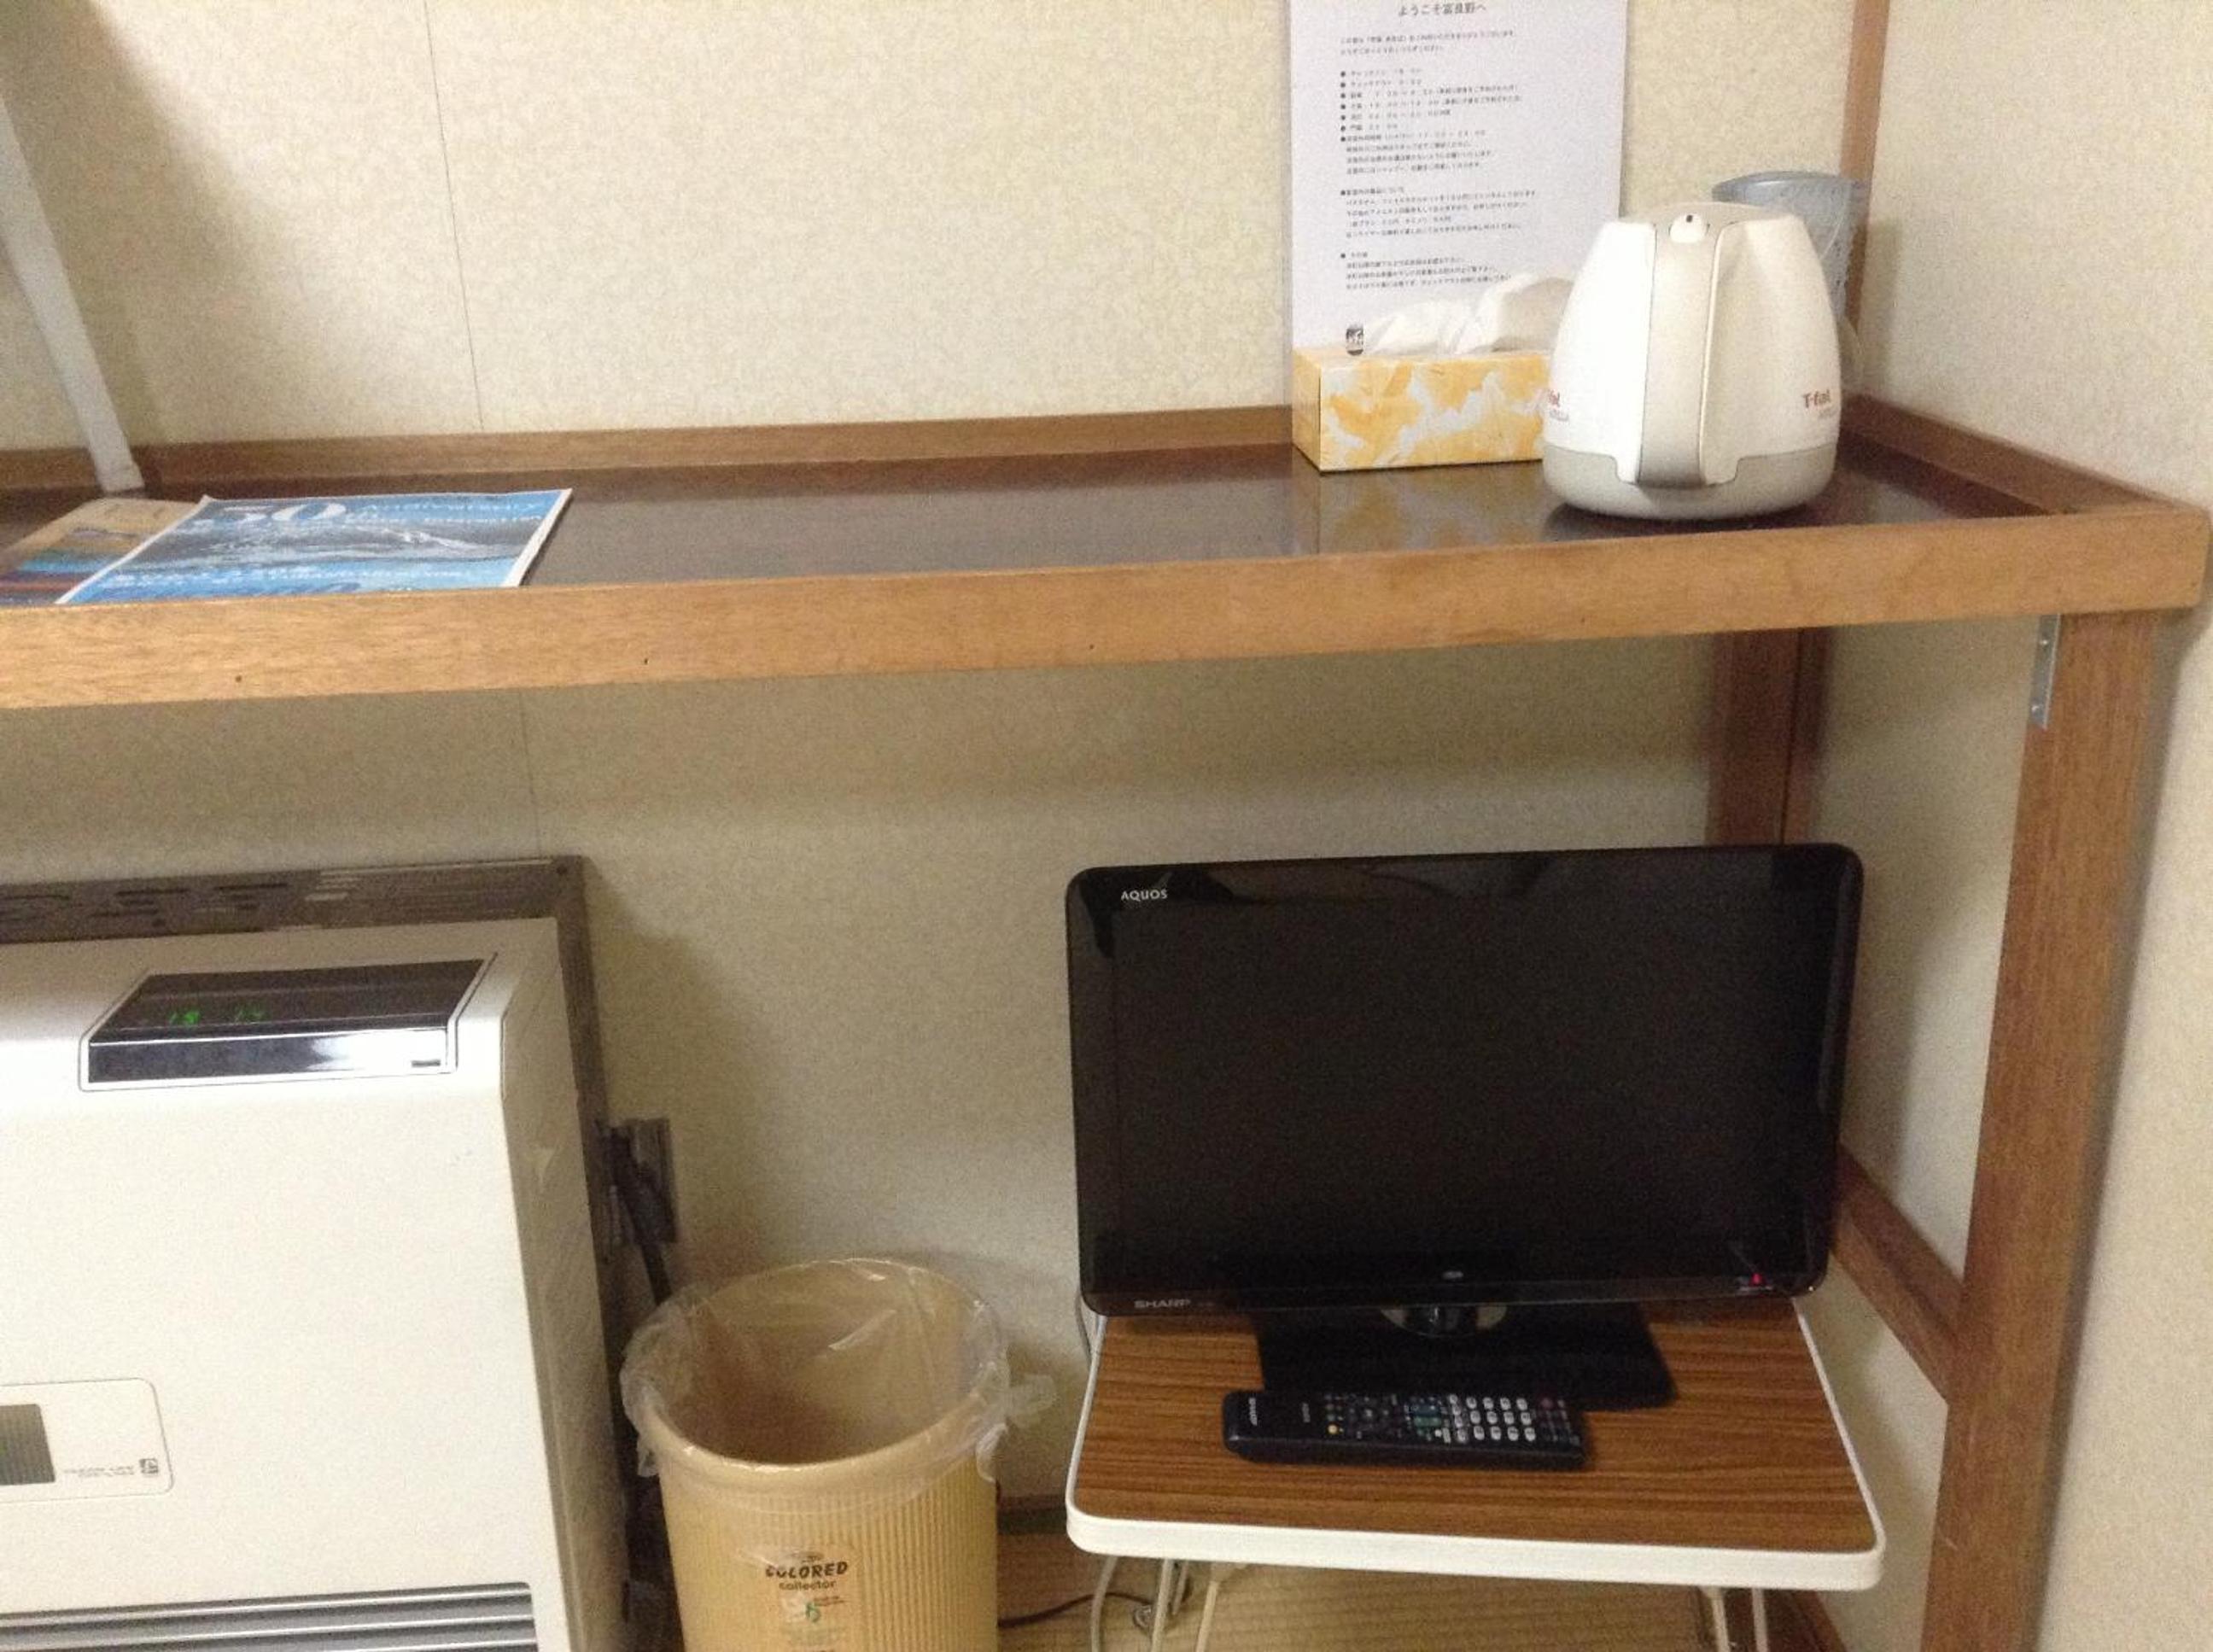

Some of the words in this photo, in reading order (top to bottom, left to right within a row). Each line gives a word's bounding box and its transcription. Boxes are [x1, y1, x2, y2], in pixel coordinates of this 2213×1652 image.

[1121, 889, 1168, 902] AQUOS
[1134, 1299, 1192, 1309] SHARP
[779, 1580, 837, 1591] collector
